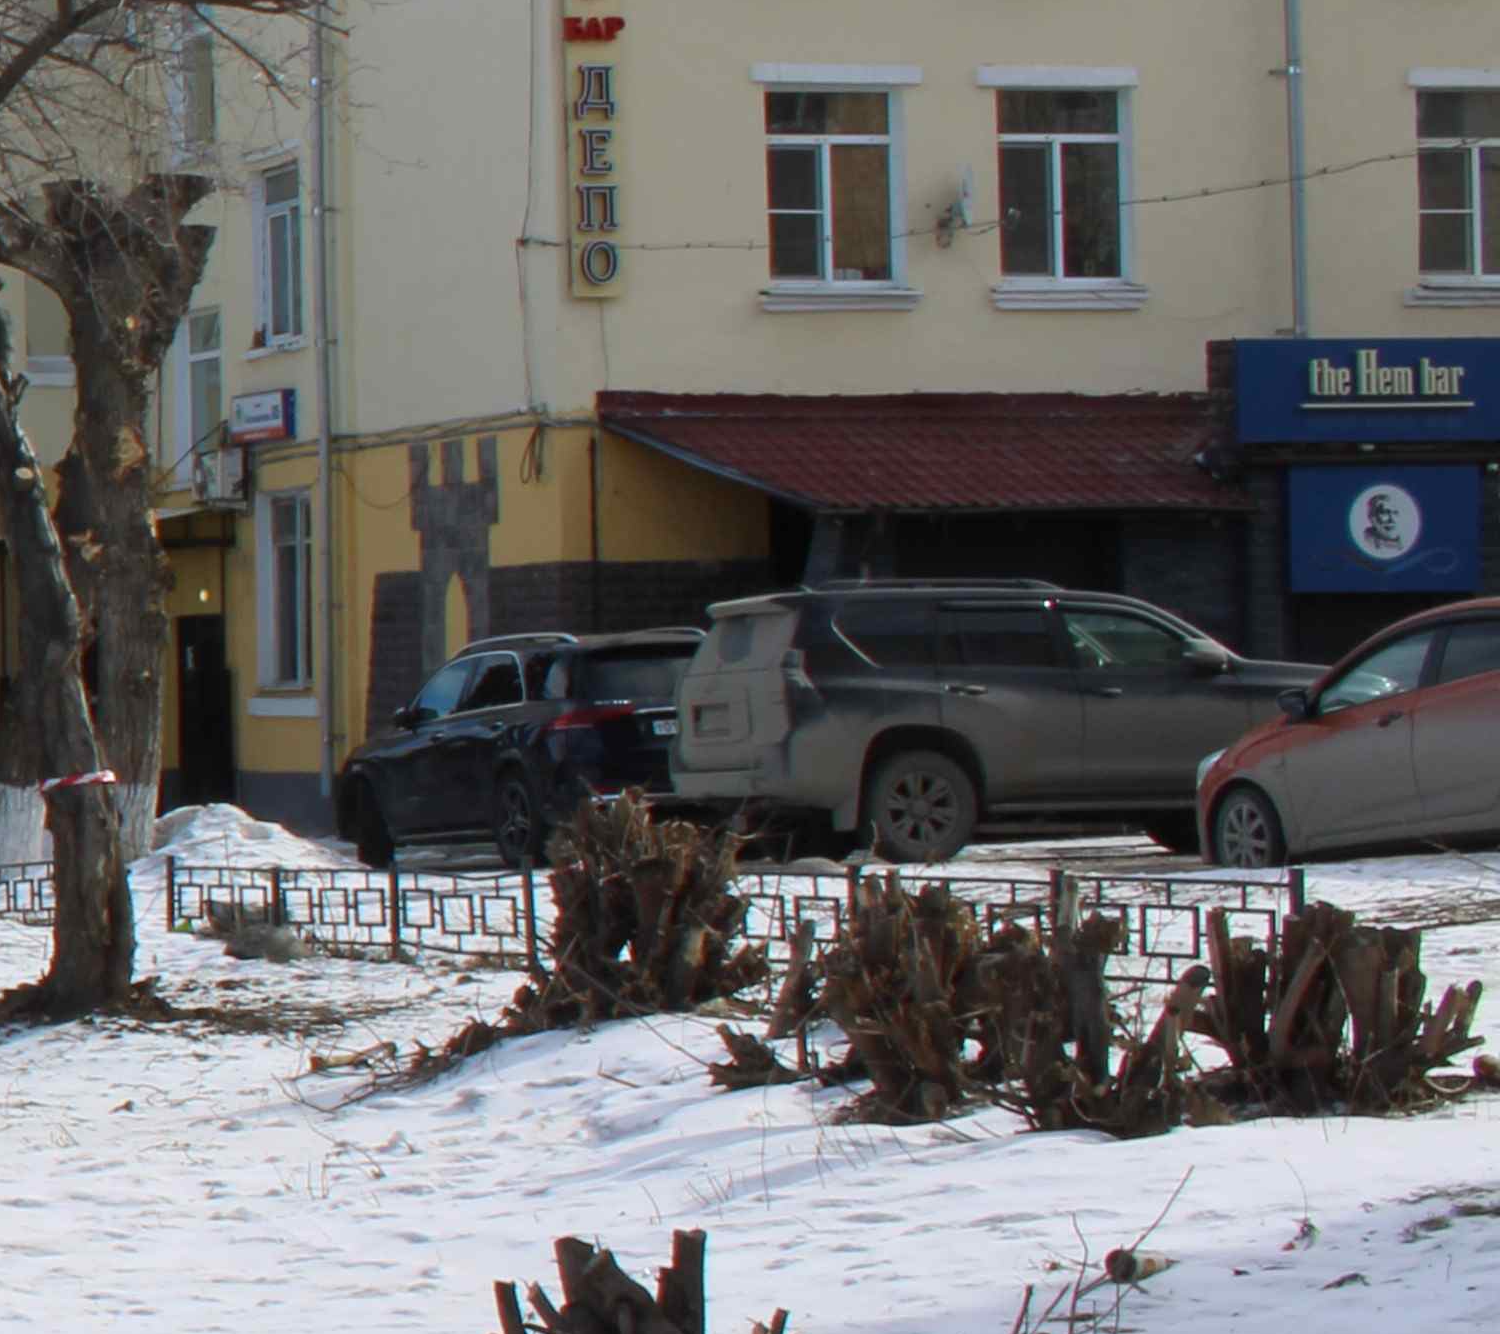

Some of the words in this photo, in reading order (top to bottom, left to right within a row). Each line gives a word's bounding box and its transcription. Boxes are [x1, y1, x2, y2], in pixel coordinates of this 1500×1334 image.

[563, 16, 626, 43] БАР
[575, 64, 620, 285] ДЕПО
[1309, 357, 1352, 396] the
[1356, 347, 1415, 396] Hem
[1419, 356, 1466, 396] bar
